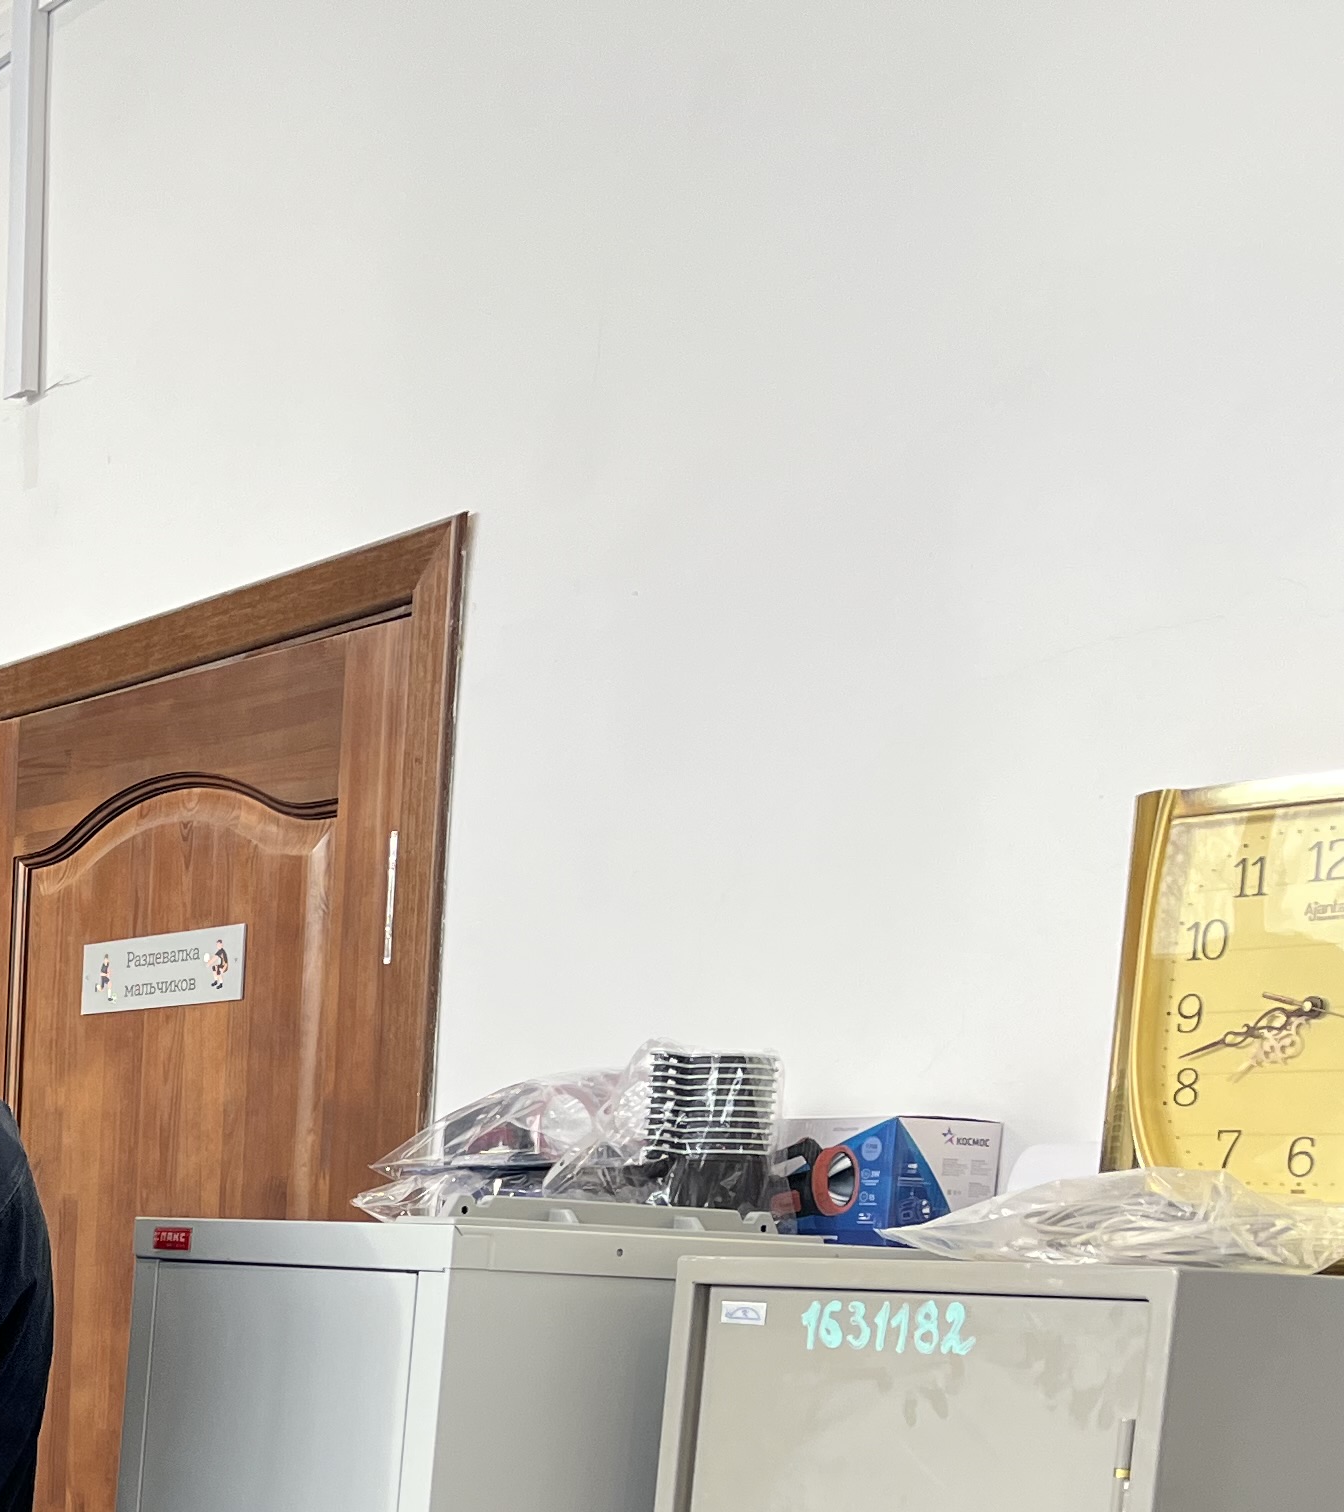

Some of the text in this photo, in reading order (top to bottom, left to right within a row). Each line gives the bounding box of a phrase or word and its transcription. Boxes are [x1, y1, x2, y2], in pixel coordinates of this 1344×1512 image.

[1233, 856, 1268, 898] 11
[126, 947, 201, 969] Раздевалка
[1186, 918, 1229, 962] 10
[124, 977, 197, 998] мальчиков
[1177, 993, 1203, 1033] 9
[1173, 1067, 1199, 1106] 8
[956, 1136, 990, 1148] КОСМОС
[1217, 1129, 1242, 1169] 7
[1287, 1136, 1316, 1177] 6
[801, 1300, 977, 1356] 1631182
